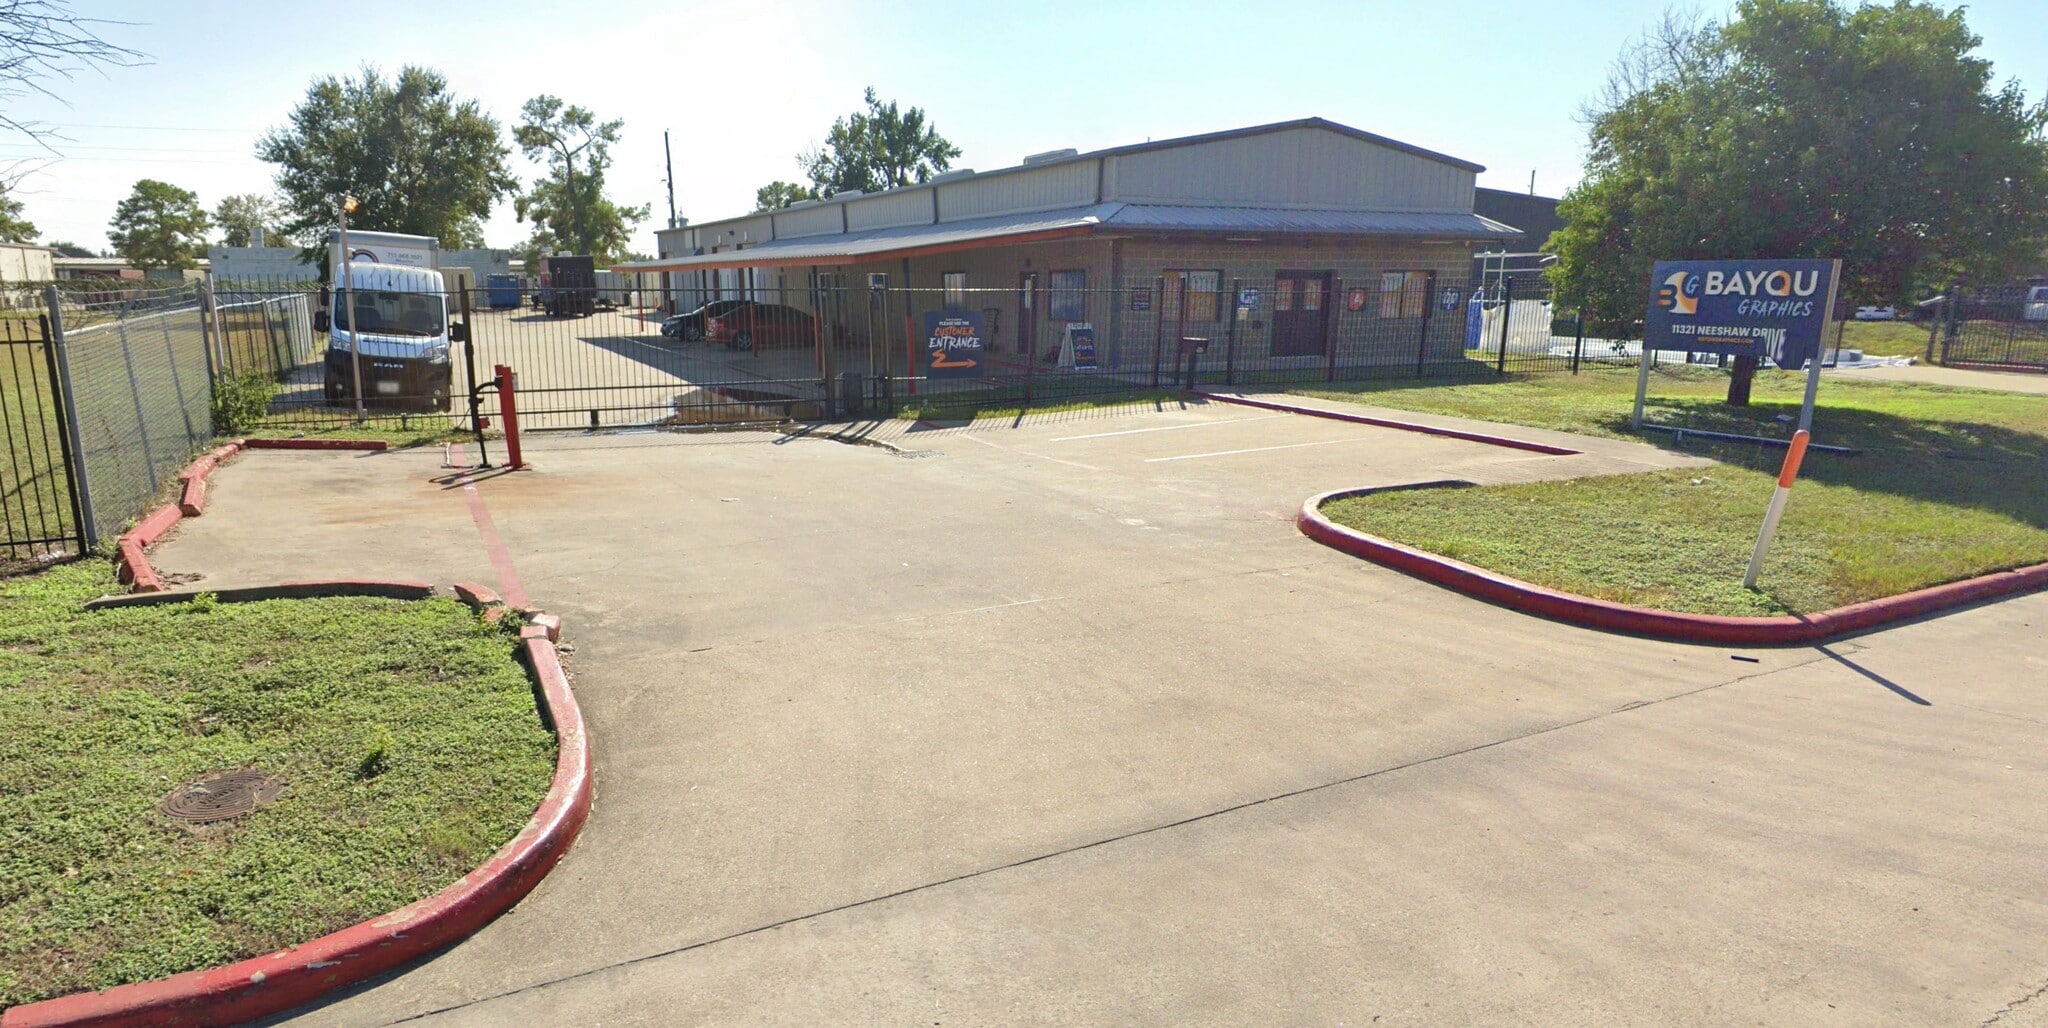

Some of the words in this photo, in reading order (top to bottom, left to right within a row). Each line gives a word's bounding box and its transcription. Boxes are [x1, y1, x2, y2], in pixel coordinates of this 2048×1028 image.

[1704, 270, 1819, 297] BAYOU
[1737, 299, 1814, 318] GRAPHICS
[934, 326, 976, 336] CUSTOMER
[928, 336, 981, 351] ENTRANCE
[1671, 324, 1696, 335] 11321
[1697, 325, 1750, 337] NEESHAW
[1752, 328, 1787, 361] DRIVE
